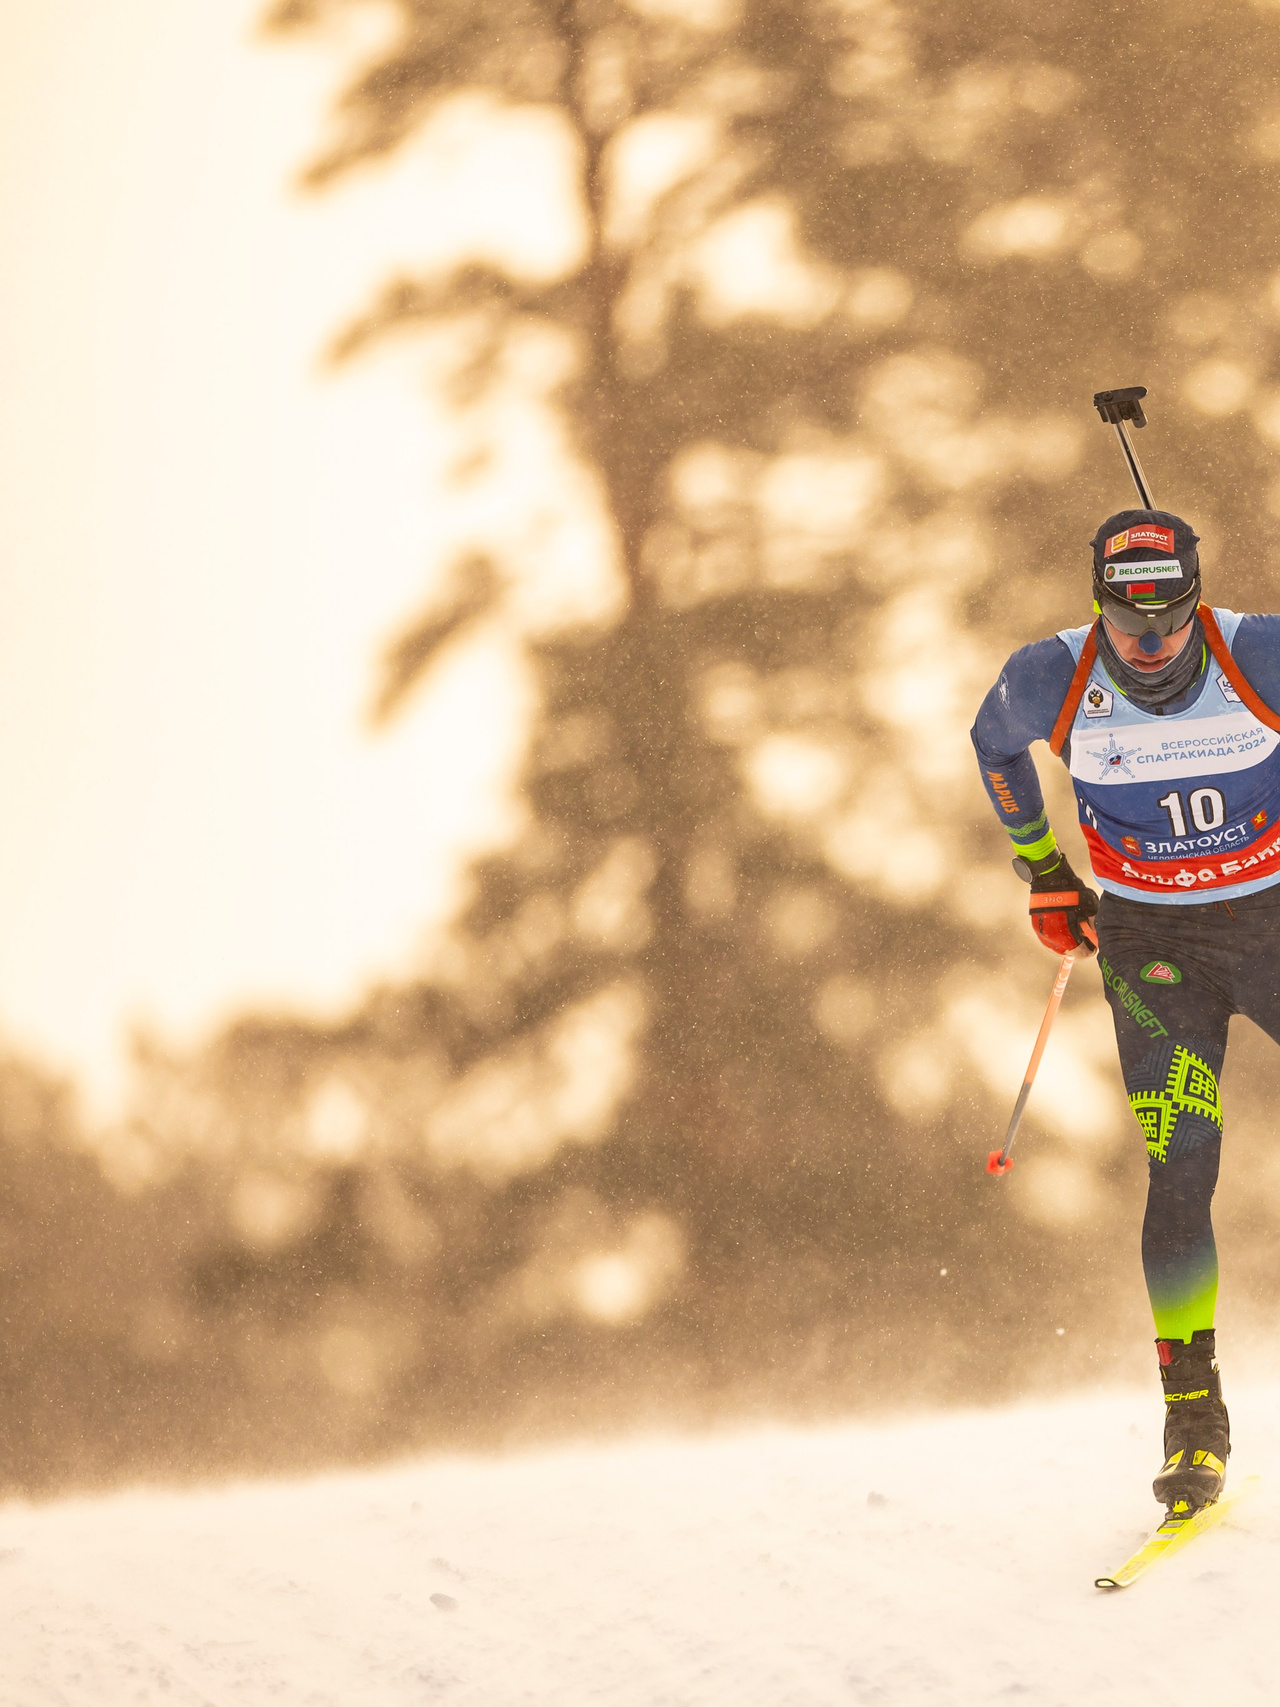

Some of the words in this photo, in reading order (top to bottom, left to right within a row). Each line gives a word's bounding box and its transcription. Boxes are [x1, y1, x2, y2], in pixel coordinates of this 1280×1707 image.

[1130, 532, 1168, 541] ЗЛАТОУСТ
[1119, 565, 1180, 576] BELORUSNEFT
[1136, 747, 1235, 764] СПАРТАКИАДА
[1237, 736, 1267, 753] 2024
[1161, 727, 1264, 751] ВСЕРОССИЙСКАЯ
[986, 771, 1020, 814] MAPLUS
[1158, 787, 1226, 837] 10
[1145, 822, 1247, 854] ЗЛАТОУСТ
[1212, 836, 1250, 854] ОБЛАСТЬ
[1101, 956, 1169, 1039] BELORUSNEFT
